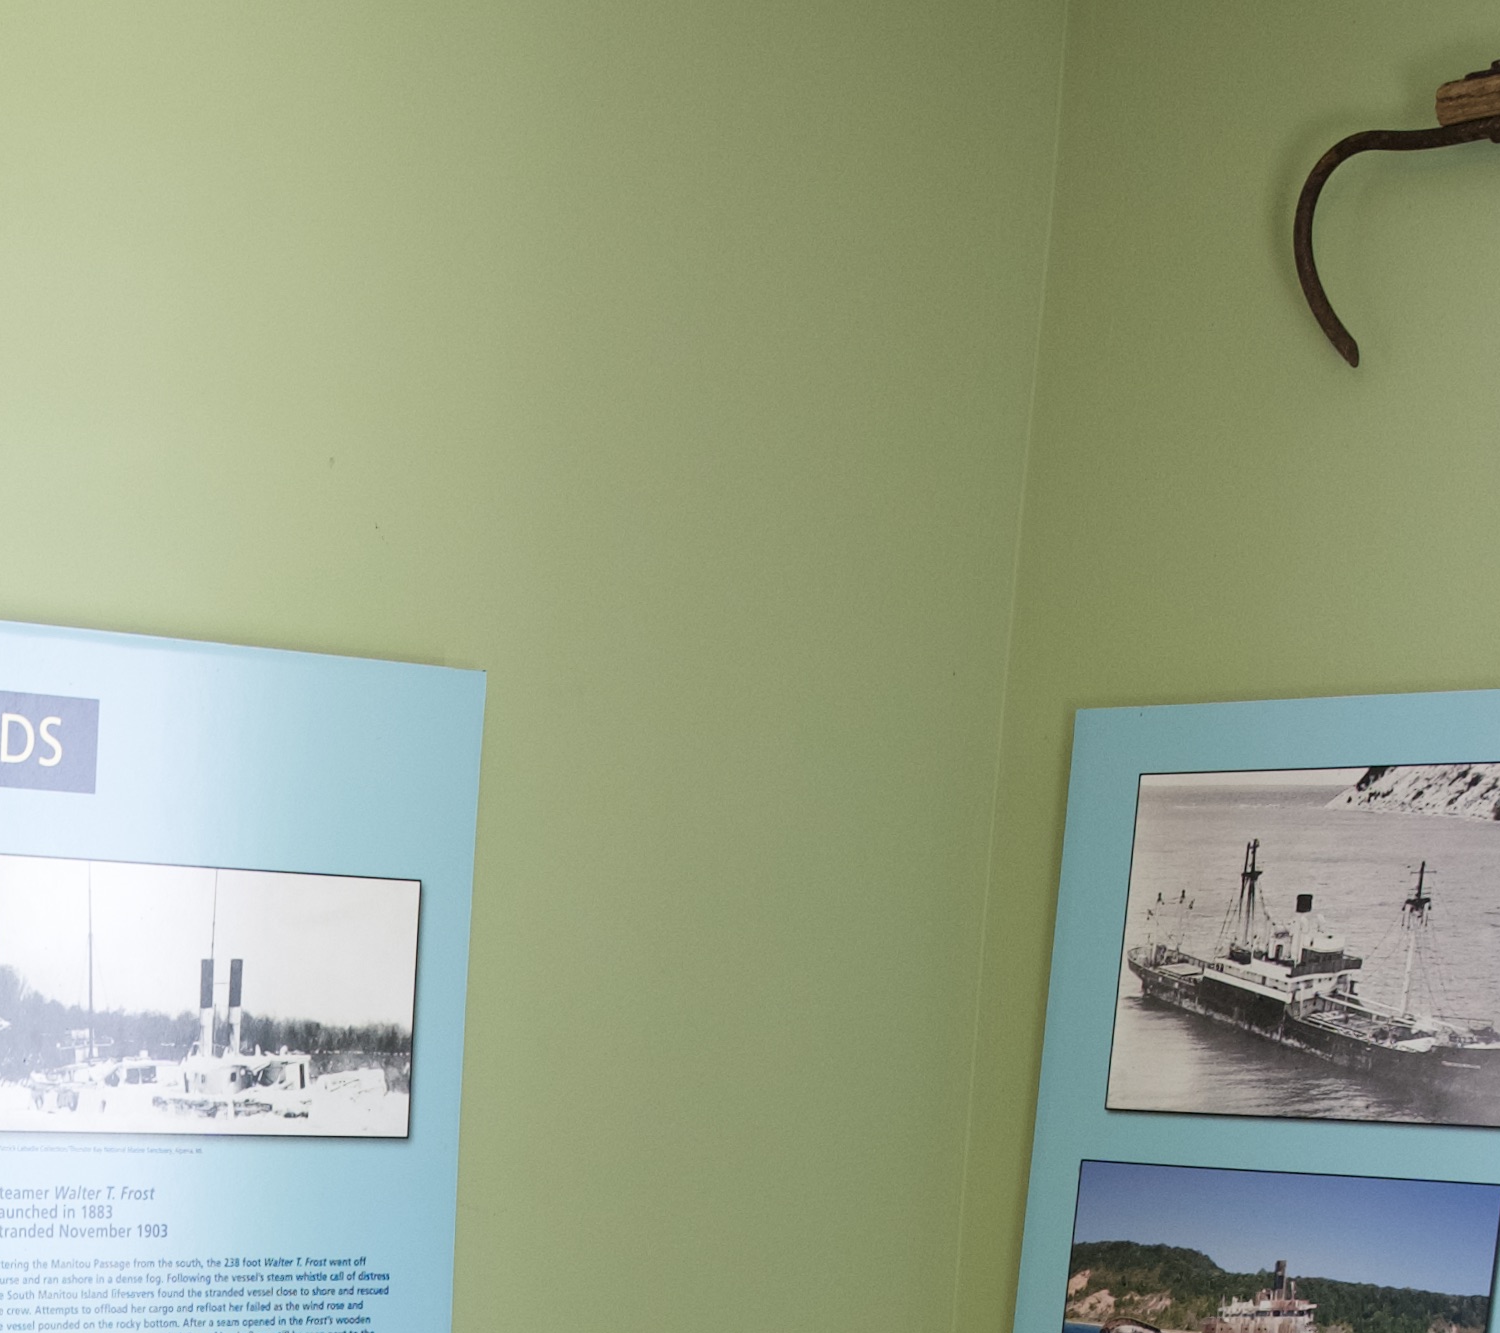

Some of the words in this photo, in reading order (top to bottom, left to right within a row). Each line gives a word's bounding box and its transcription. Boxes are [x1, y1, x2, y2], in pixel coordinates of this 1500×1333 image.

[54, 1185, 102, 1201] Walter
[106, 1185, 116, 1200] T.
[120, 1185, 156, 1201] Frost
[63, 1204, 76, 1219] in
[81, 1204, 113, 1220] 1883
[59, 1223, 132, 1239] November
[137, 1223, 168, 1239] 1903
